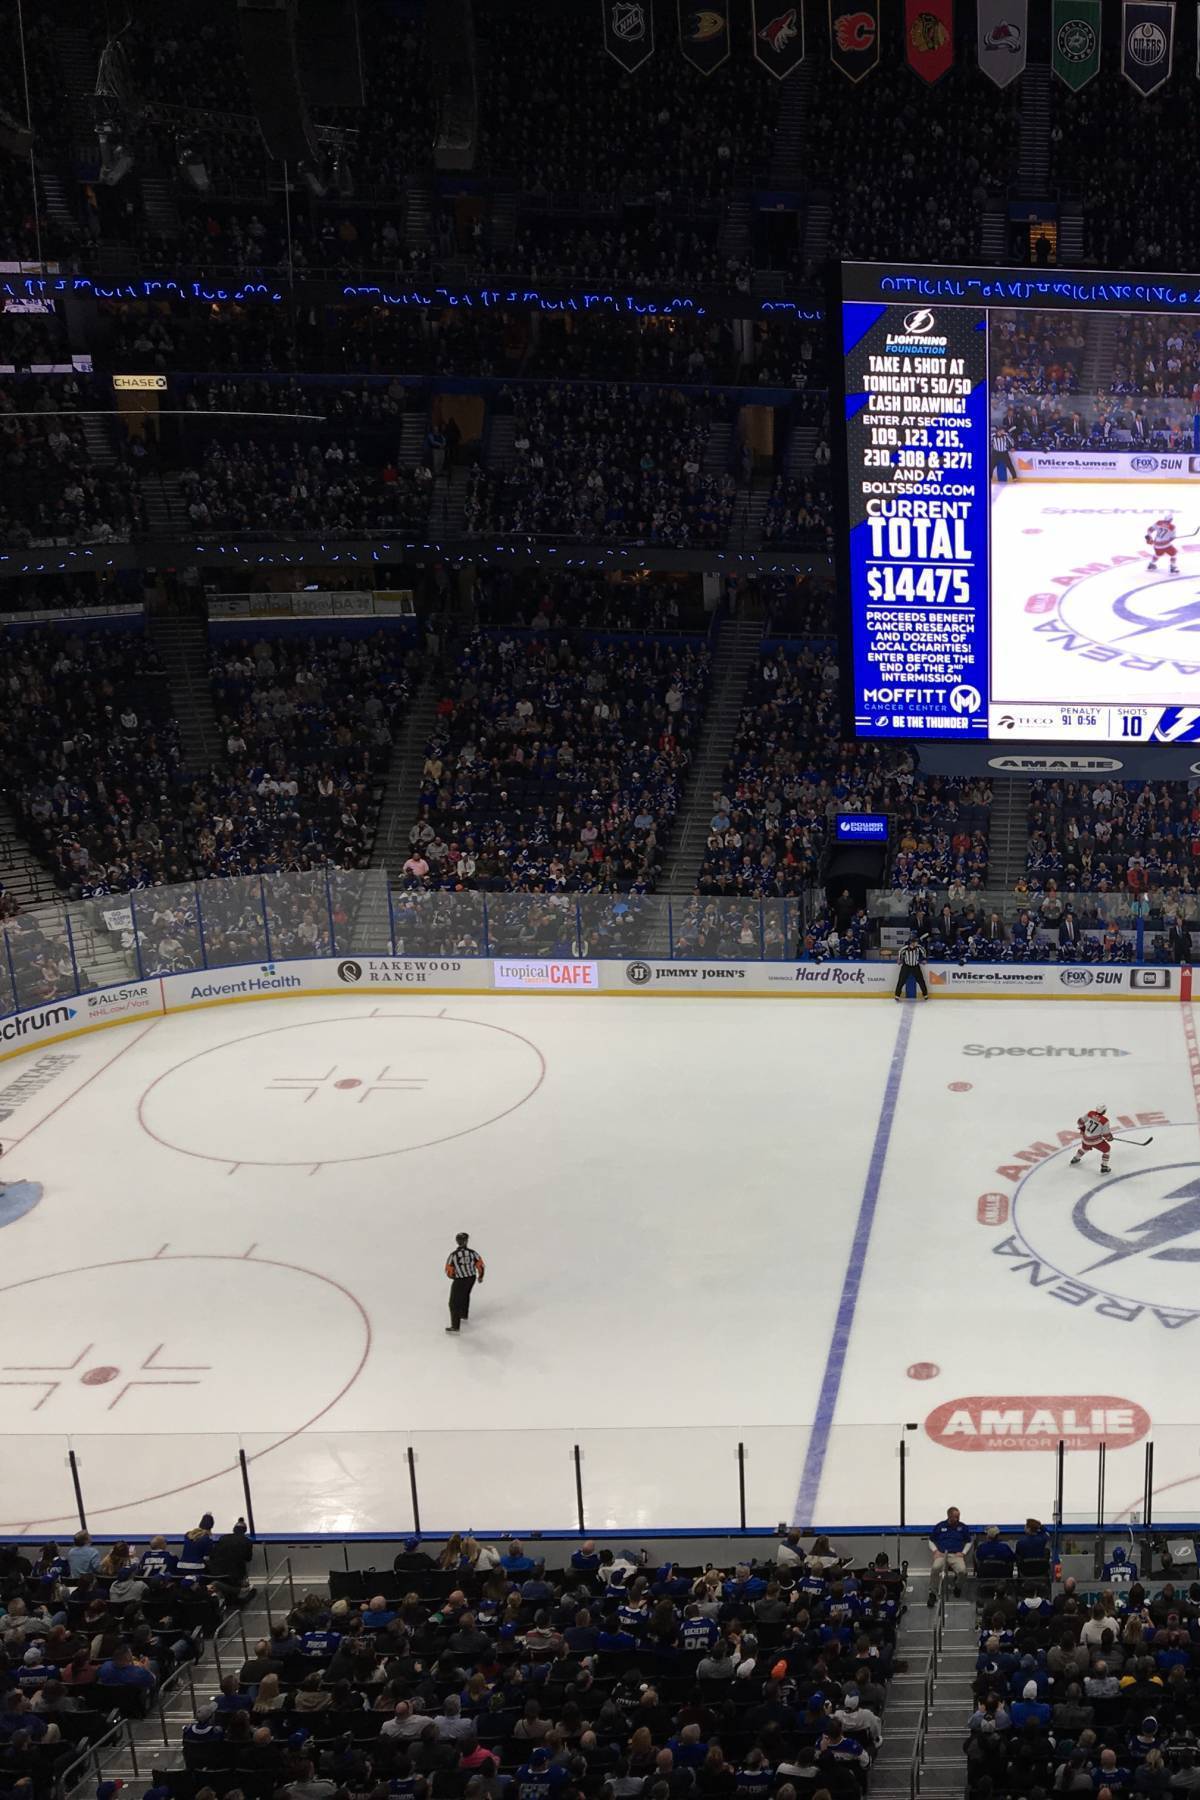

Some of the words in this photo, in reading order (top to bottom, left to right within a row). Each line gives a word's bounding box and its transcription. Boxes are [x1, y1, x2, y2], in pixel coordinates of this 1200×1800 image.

[886, 334, 948, 346] LIGHTNING
[885, 345, 946, 355] FOUNDATION
[868, 356, 901, 373] TAKE
[902, 357, 912, 373] A
[914, 357, 947, 374] SHOT
[949, 358, 965, 375] AT
[114, 378, 155, 387] CHASE
[863, 375, 928, 395] TONIGHT'S
[930, 377, 972, 395] 50/50
[868, 395, 902, 412] CASH
[903, 396, 967, 414] DRAWING!
[862, 415, 900, 425] ENTER
[901, 416, 916, 426] AT
[917, 417, 973, 428] SECTIONS
[871, 427, 902, 447] 109,
[904, 429, 933, 448] 123,
[936, 430, 964, 448] 215,
[864, 449, 895, 468] 230,
[898, 450, 926, 468] 308
[928, 452, 940, 468] &
[943, 452, 973, 469] 327!
[1160, 458, 1182, 470] SUN
[893, 469, 925, 481] AND
[926, 470, 945, 482] AT
[862, 481, 975, 497] BOLTS5050.COM
[866, 499, 973, 519] CURRENT
[867, 516, 973, 560] TOTAL
[866, 566, 970, 604] $14475
[866, 611, 927, 623] PROCEEDS
[928, 613, 976, 623] BENEFIT
[866, 621, 914, 632] CANCER
[915, 622, 975, 633] RESEARCH
[875, 632, 901, 642] AND
[902, 633, 949, 643] DOZENS
[950, 634, 967, 643] OF
[870, 641, 908, 652] LOCAL
[909, 643, 972, 653] CHARITIES!
[867, 652, 905, 663] ENTER
[906, 653, 951, 664] BEFORE
[952, 654, 975, 664] THE
[879, 663, 903, 673] END
[905, 663, 921, 673] OF
[922, 664, 946, 674] THE
[947, 664, 964, 674] 2ND
[881, 673, 962, 683] INTERMISSION
[863, 688, 947, 704] MOFFITT
[863, 703, 904, 712] CANCER
[908, 704, 947, 712] CENTER
[1060, 707, 1102, 716] PENALTY
[1117, 708, 1148, 716] SHOTS
[892, 715, 907, 728] BE
[906, 716, 925, 729] THE
[925, 717, 969, 730] THUNDER
[1061, 715, 1072, 725] 91
[1077, 715, 1097, 726] 0:56
[1121, 716, 1142, 737] 10
[1000, 759, 1114, 769] AMALIE
[368, 961, 462, 972] LAKEWOOD
[370, 973, 427, 982] RANCH
[500, 964, 549, 979] tropical
[550, 965, 592, 984] CAFE
[655, 968, 698, 979] JIMMY
[702, 969, 746, 979] JOHN'S
[795, 967, 830, 982] Hard
[832, 967, 865, 985] Rock
[952, 971, 1043, 981] MicroLumen
[1066, 971, 1086, 980] FOX
[1096, 972, 1122, 985] SUN
[190, 975, 301, 1000] AdventHealth
[0, 1006, 69, 1042] ctrum
[961, 1044, 1120, 1058] Spectrum
[1086, 1119, 1100, 1135] 27
[995, 1110, 1171, 1183] AMAIE
[941, 1409, 1135, 1435] AMALIE
[988, 1438, 1050, 1447] MOTOR
